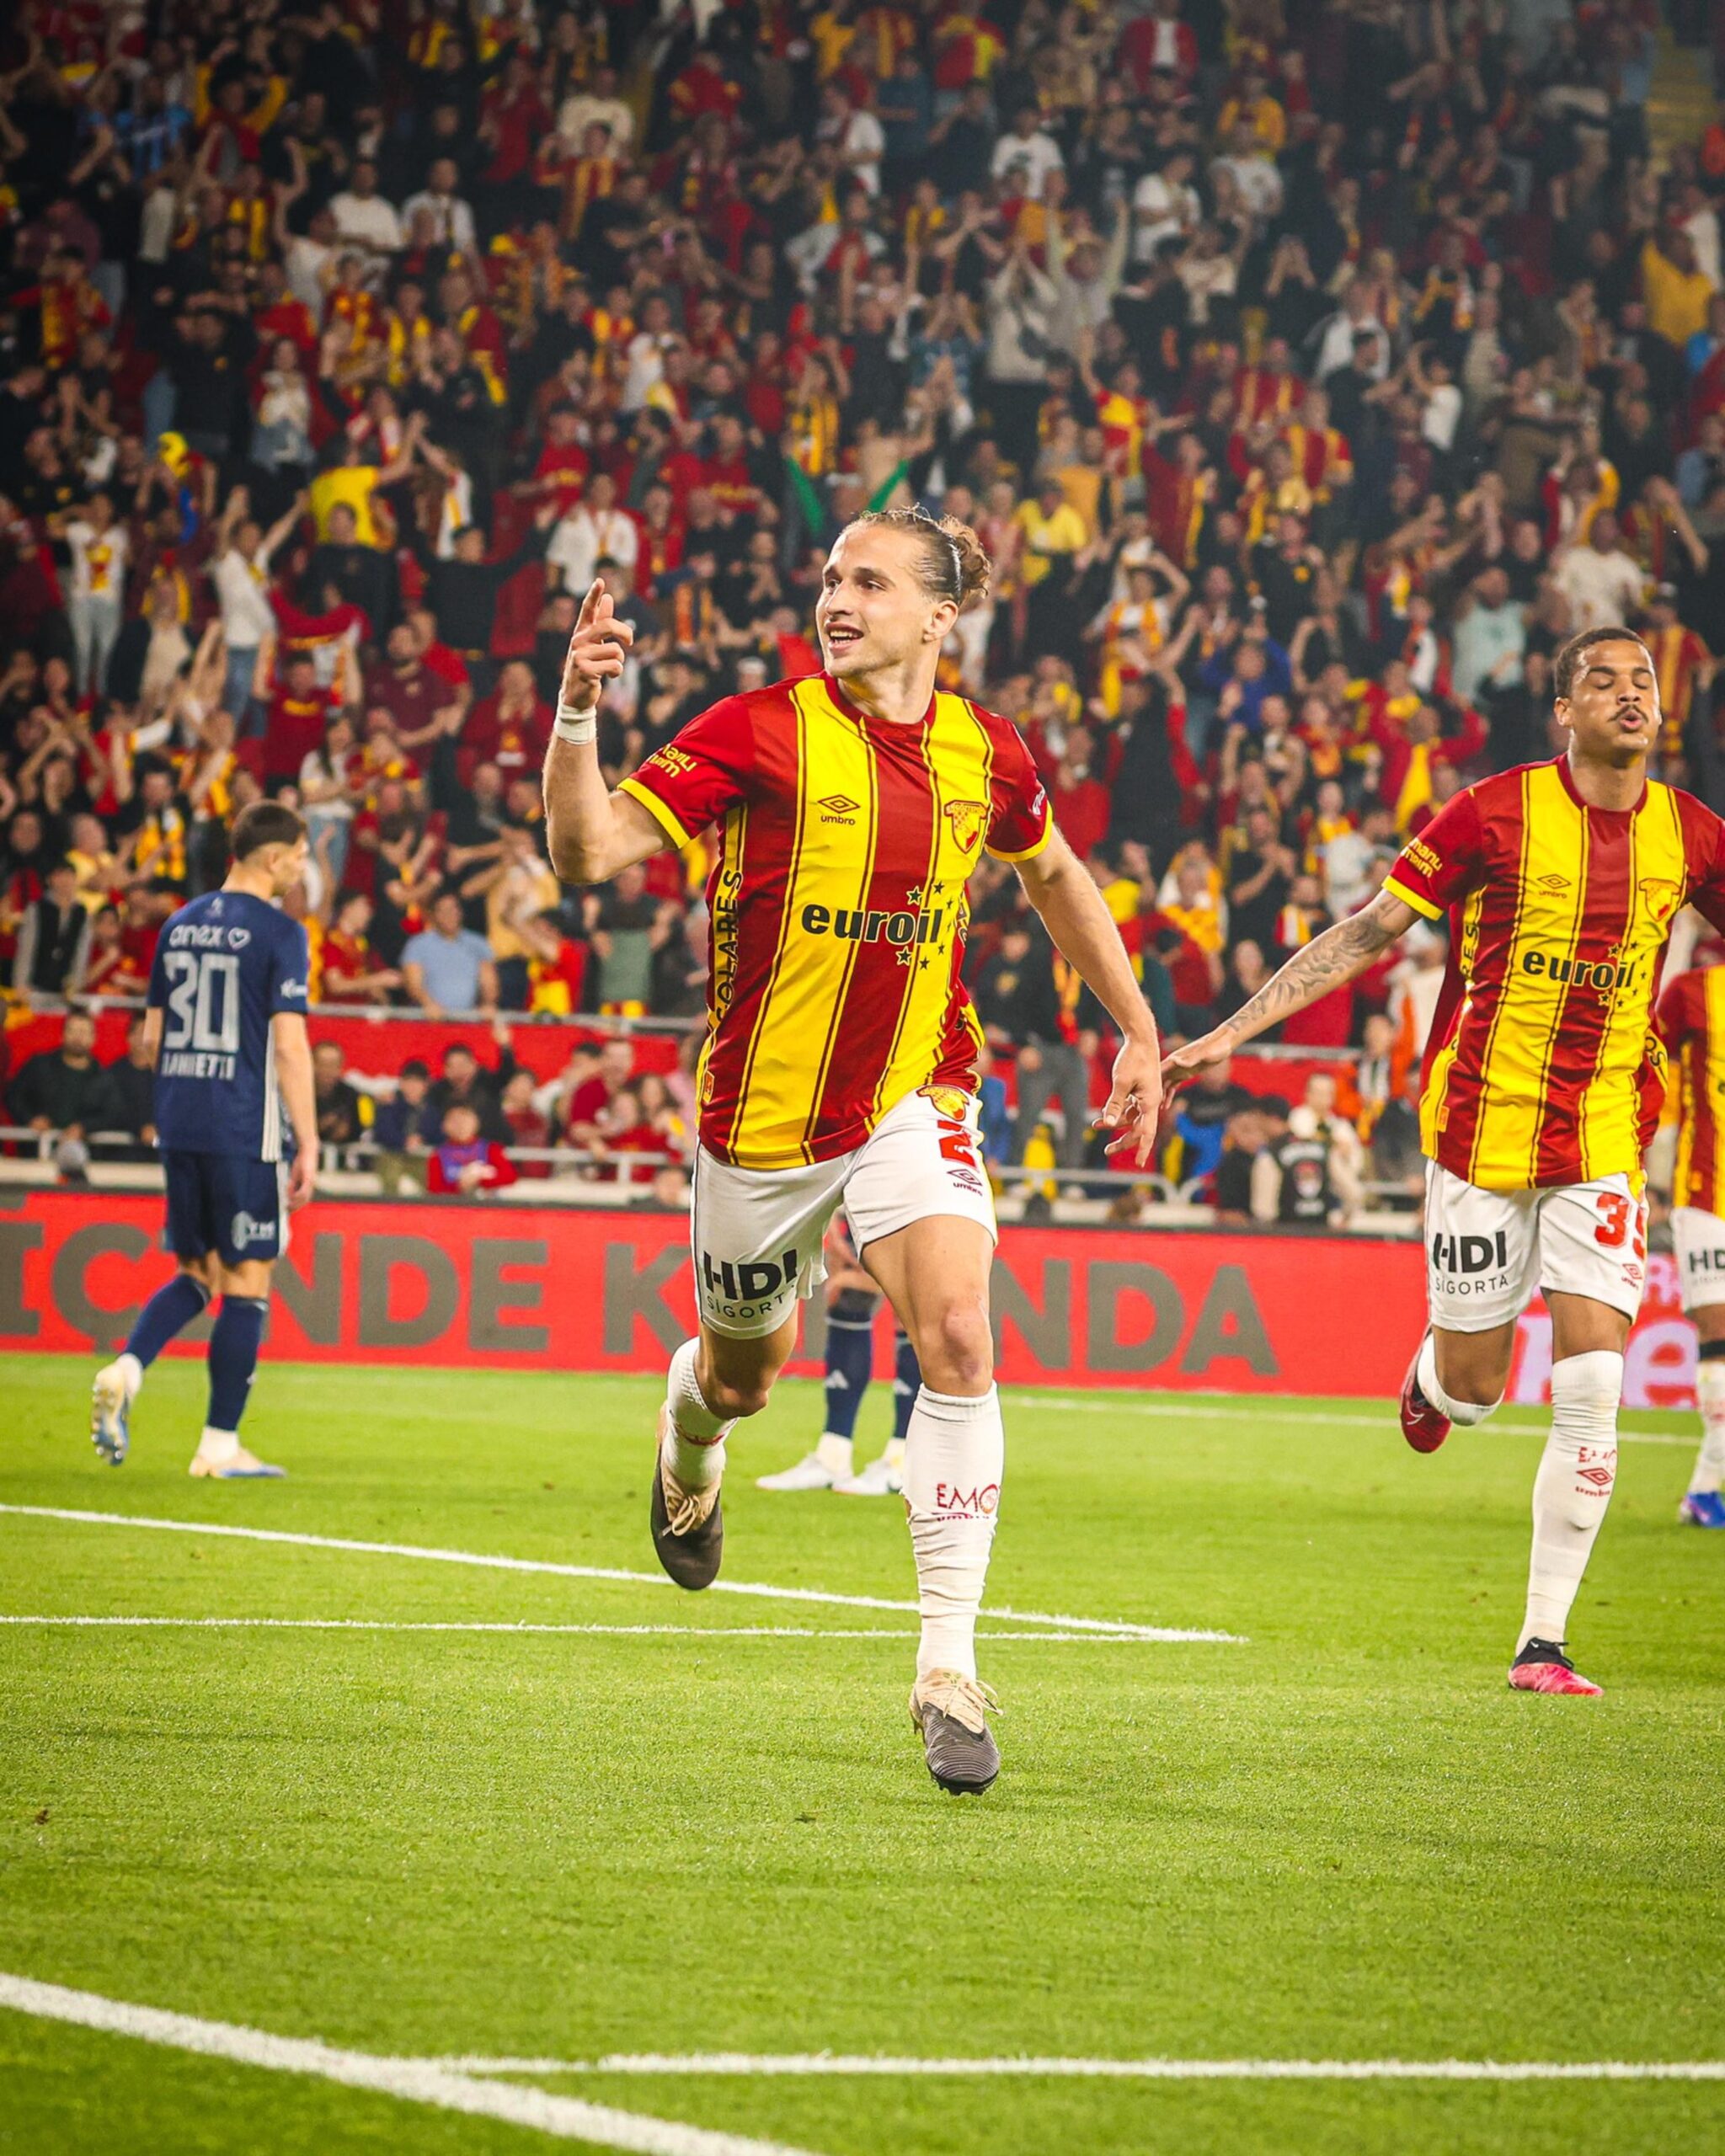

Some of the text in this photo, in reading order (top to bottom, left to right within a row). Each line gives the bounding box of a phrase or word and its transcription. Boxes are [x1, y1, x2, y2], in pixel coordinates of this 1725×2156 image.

[820, 814, 856, 825] umbro
[1539, 890, 1567, 899] umbro
[169, 925, 223, 947] anex
[801, 904, 943, 944] euroil
[1522, 951, 1636, 989] euroil
[163, 950, 241, 1054] 30
[1434, 1230, 1506, 1273] HDI
[1689, 1249, 1725, 1273] HD
[703, 1249, 797, 1300] HDI
[707, 1284, 794, 1318] SİGORT
